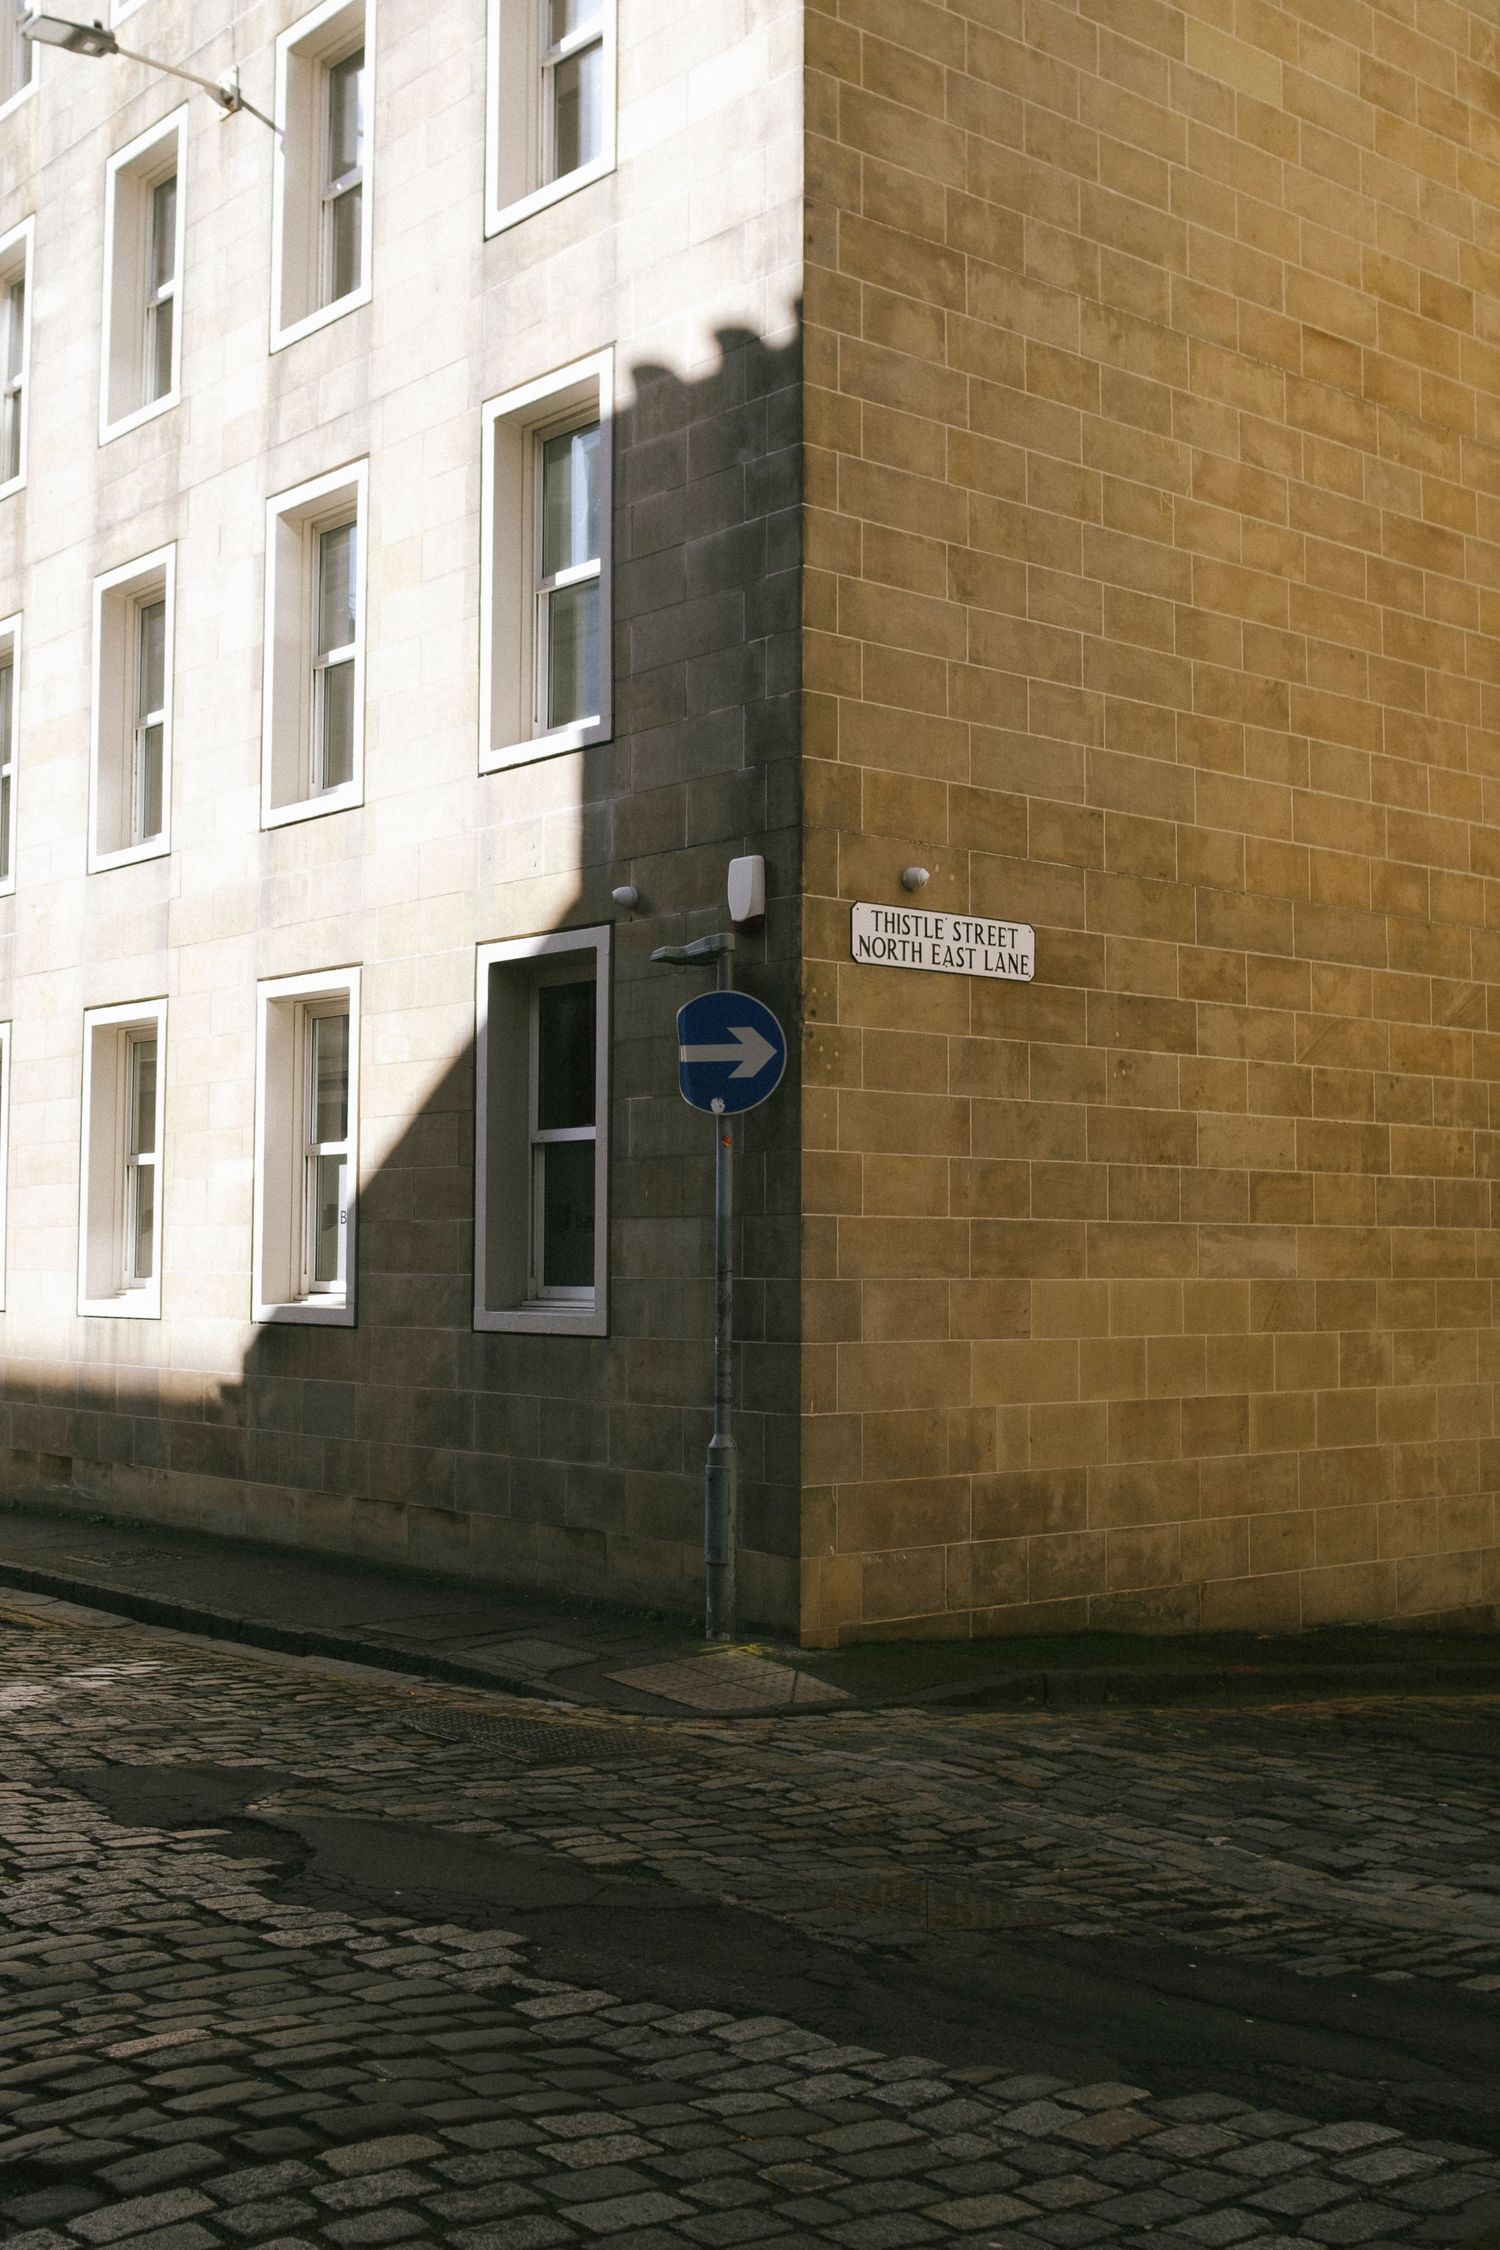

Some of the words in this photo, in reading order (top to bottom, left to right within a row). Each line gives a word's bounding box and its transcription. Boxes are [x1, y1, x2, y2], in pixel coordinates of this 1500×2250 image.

[871, 909, 944, 940] THISTLE
[952, 921, 1019, 949] STREET
[858, 934, 923, 964] NORTH
[931, 943, 977, 969] EAST
[984, 949, 1030, 977] LANE
